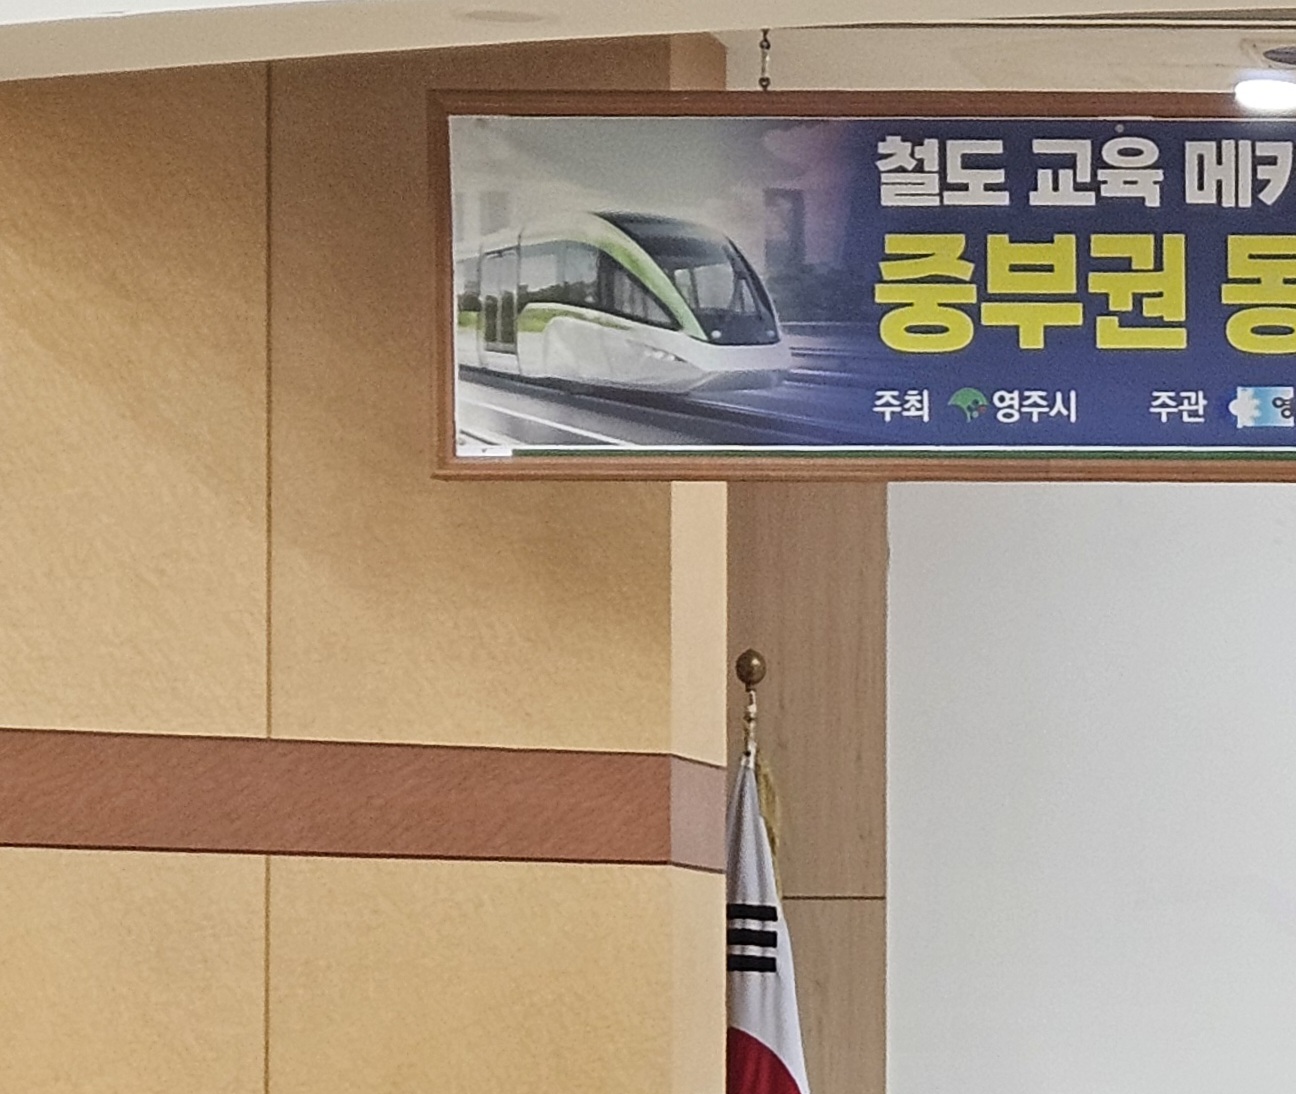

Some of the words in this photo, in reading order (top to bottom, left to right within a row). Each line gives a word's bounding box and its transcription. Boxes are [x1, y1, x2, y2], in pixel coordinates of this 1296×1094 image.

[876, 136, 1011, 208] 철도
[1030, 137, 1166, 209] 교육
[874, 233, 1188, 355] 중부권
[872, 390, 931, 424] 주최
[992, 390, 1078, 425] 영주시
[1149, 391, 1209, 424] 주관
